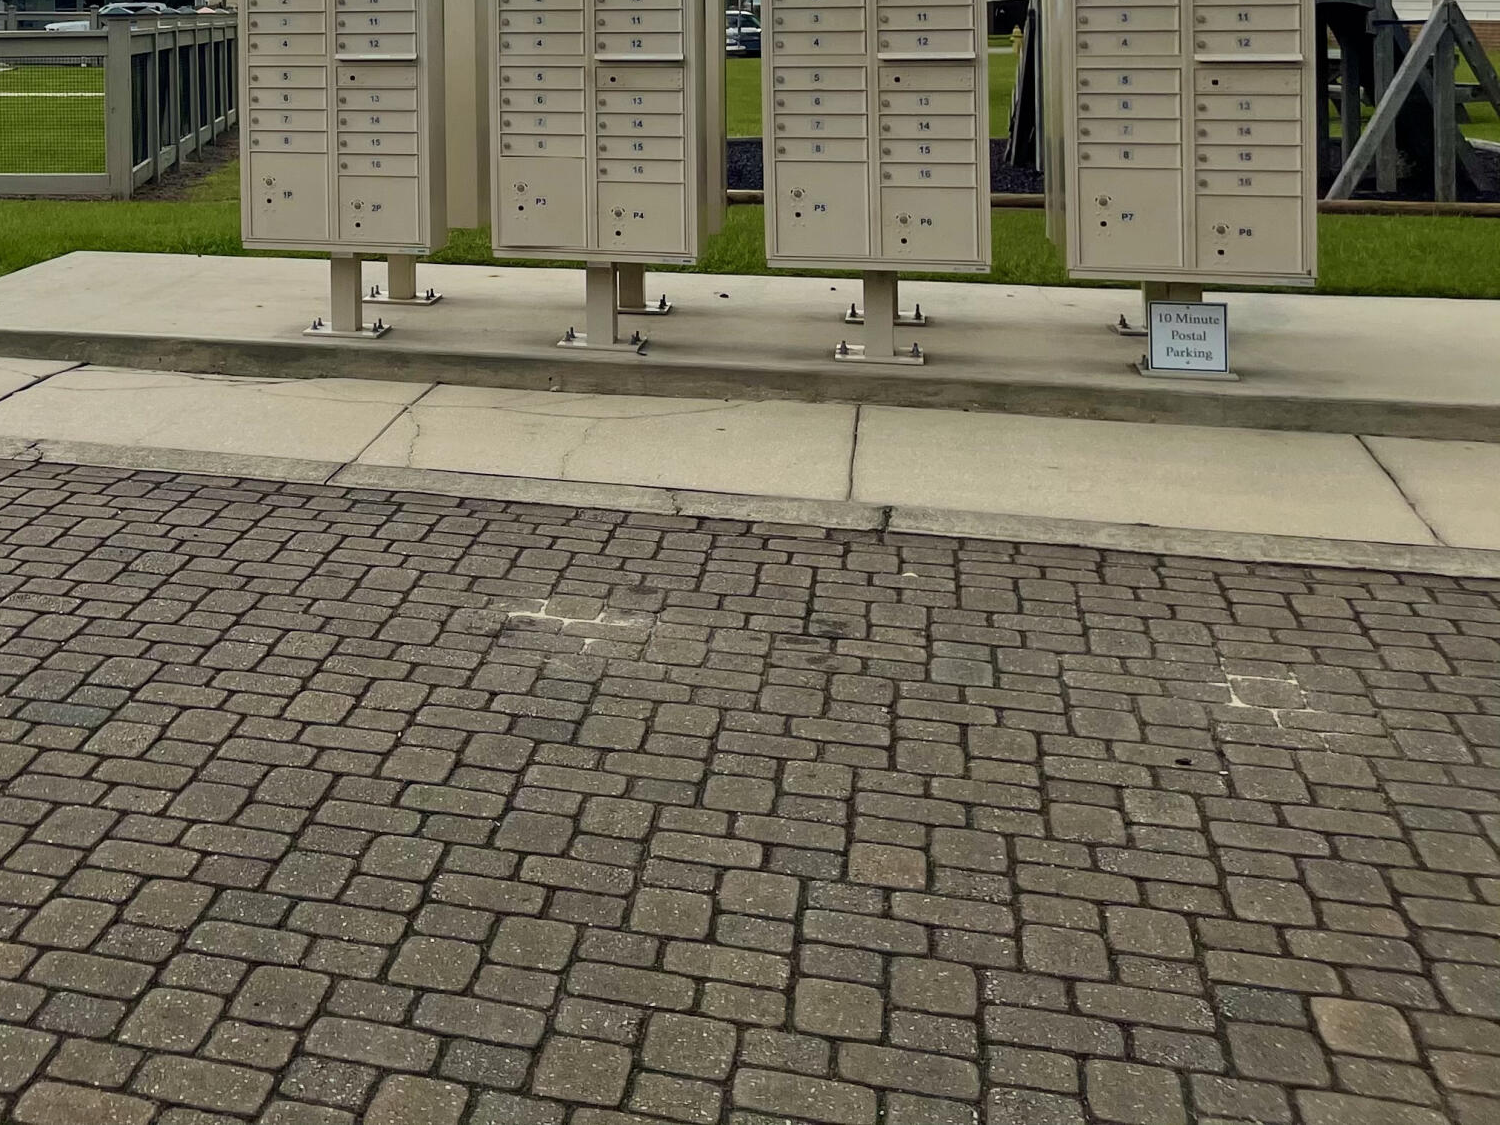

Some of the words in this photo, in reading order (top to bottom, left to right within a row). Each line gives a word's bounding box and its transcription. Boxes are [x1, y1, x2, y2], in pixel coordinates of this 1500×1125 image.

[917, 13, 927, 21] 11
[1238, 13, 1249, 21] 11
[369, 40, 379, 48] 12
[631, 40, 642, 48] 12
[917, 37, 928, 45] 12
[1238, 38, 1250, 47] 12
[370, 95, 380, 103] 13
[632, 97, 643, 105] 13
[919, 98, 929, 106] 13
[1239, 102, 1250, 110] 13
[919, 122, 930, 130] 14
[1239, 128, 1251, 136] 14
[632, 143, 643, 151] 15
[919, 146, 930, 154] 15
[1239, 152, 1252, 161] 15
[632, 166, 643, 174] 16
[920, 170, 931, 178] 16
[283, 191, 292, 199] 1P
[371, 204, 381, 212] 2P
[815, 204, 826, 212] P5
[1121, 213, 1134, 221] P7
[921, 218, 932, 226] P6
[1159, 313, 1172, 323] 10
[1175, 313, 1220, 325] Minute
[1171, 330, 1206, 341] Postal
[1166, 346, 1213, 361] Parking
